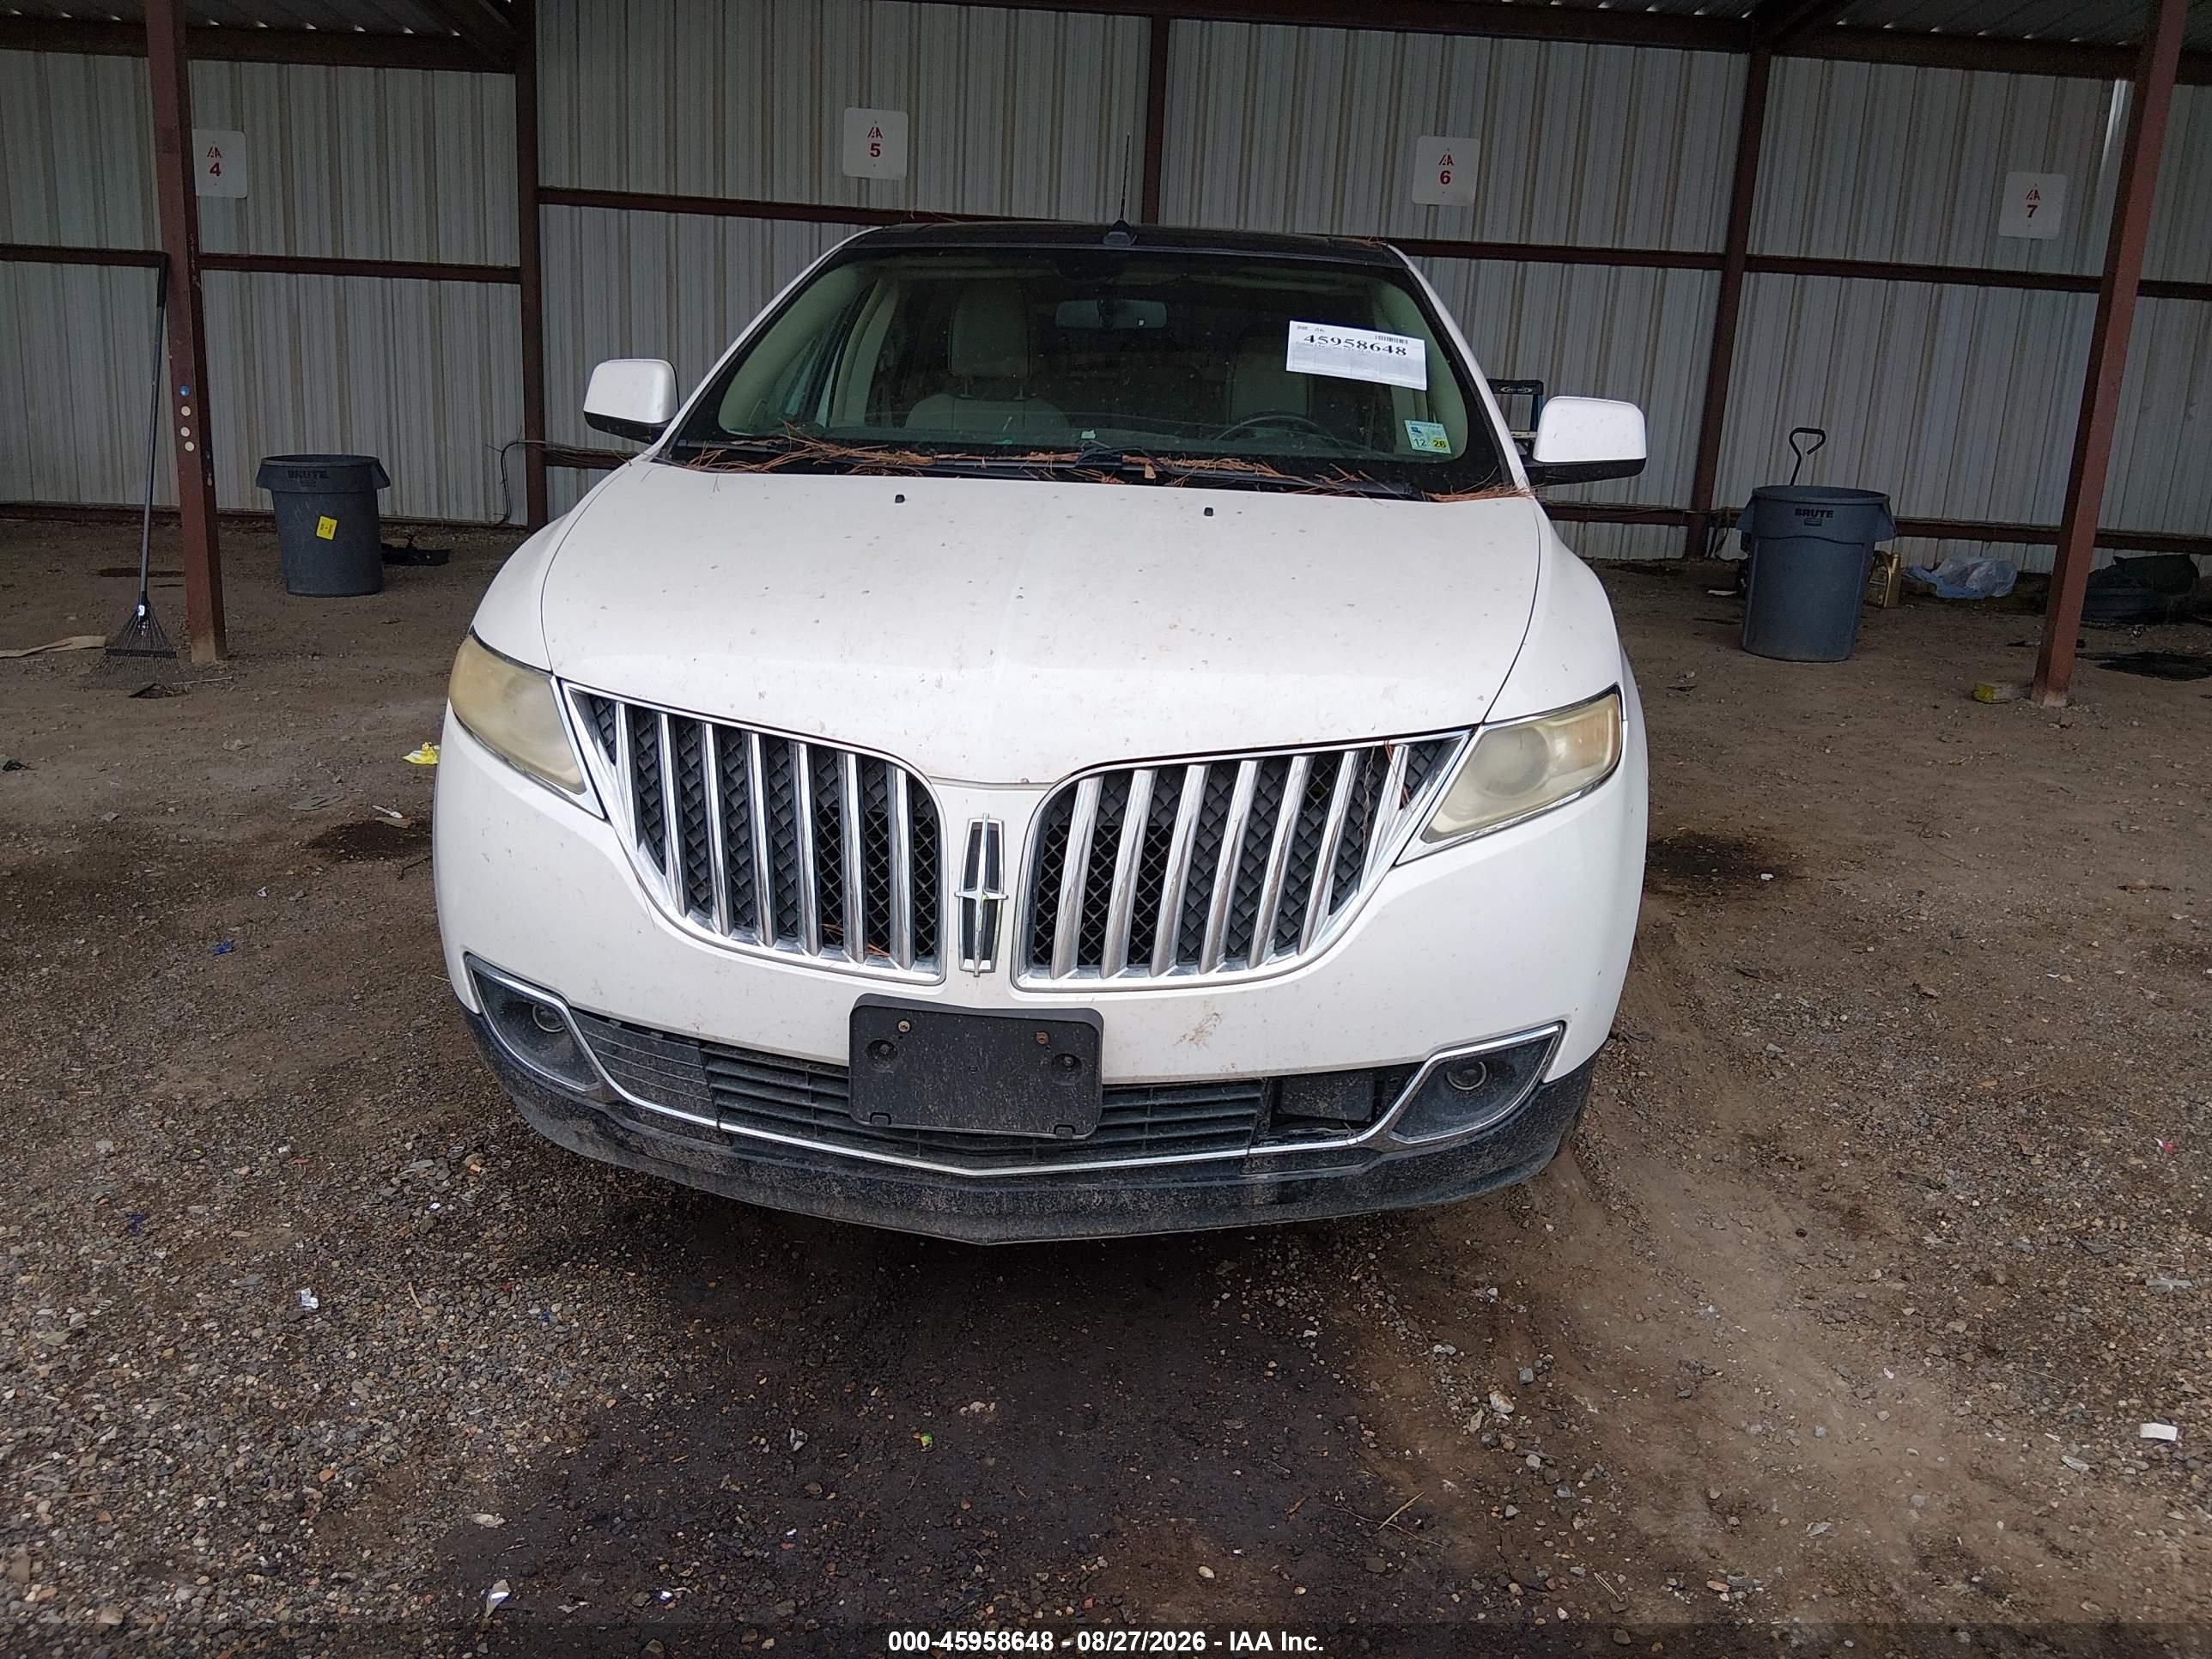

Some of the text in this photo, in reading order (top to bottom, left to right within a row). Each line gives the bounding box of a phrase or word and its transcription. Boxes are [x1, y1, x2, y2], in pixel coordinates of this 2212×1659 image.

[870, 143, 881, 158] 5
[209, 162, 222, 177] 4
[1440, 170, 1451, 185] 6
[2027, 204, 2039, 218] 7
[1304, 334, 1407, 356] 45958648
[1413, 438, 1427, 447] 12
[1795, 507, 1834, 519] BRUTE
